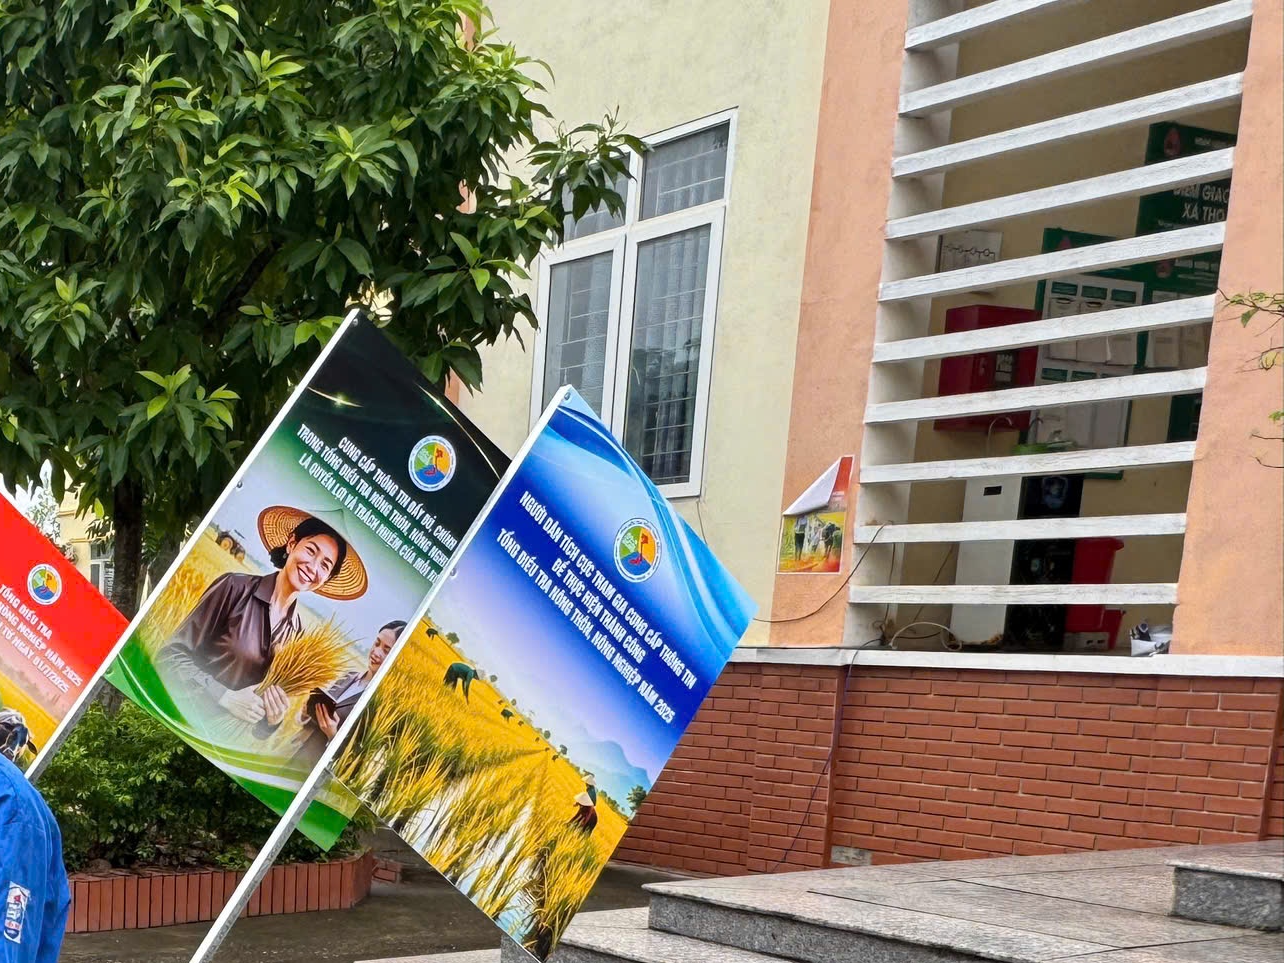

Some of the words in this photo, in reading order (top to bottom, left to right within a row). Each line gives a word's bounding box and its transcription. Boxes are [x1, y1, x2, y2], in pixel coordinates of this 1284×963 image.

[297, 424, 324, 453] TRONG
[356, 479, 372, 499] TRA
[369, 491, 392, 517] NÔNG
[409, 524, 432, 552] NÔNG
[428, 548, 449, 568] NGHI
[298, 453, 313, 469] LÀ
[343, 493, 359, 511] VÀ
[354, 502, 380, 531] TRÁCH
[376, 523, 403, 552] NHIỆM
[399, 543, 417, 565] CỦA
[338, 437, 361, 462] CUNG
[358, 457, 376, 474] CẤP
[373, 468, 399, 496] THÔNG
[395, 489, 411, 507] TIN
[36, 621, 53, 640] TRA
[519, 490, 548, 525] NGƯỜI
[542, 517, 564, 543] DÂN
[559, 534, 581, 562] TÍCH
[576, 554, 595, 578] CỰC
[592, 570, 616, 601] THAM
[611, 593, 629, 616] GIA
[624, 607, 649, 637] CUNG
[644, 628, 663, 651] CẤP
[659, 643, 686, 677] THÔNG
[681, 668, 698, 691] TIN
[562, 569, 586, 598] THỰC
[581, 590, 604, 618] HIỆN
[599, 608, 627, 643] THÀNH
[622, 635, 646, 664] CÔNG
[62, 665, 83, 687] 2025
[534, 569, 553, 594] TRA
[548, 585, 574, 616] NÔNG
[570, 607, 594, 641] THÔN,
[591, 630, 616, 663] NÔNG
[611, 652, 642, 686] NGHIỆP
[637, 680, 659, 707] NĂM
[653, 698, 676, 724] 2025
